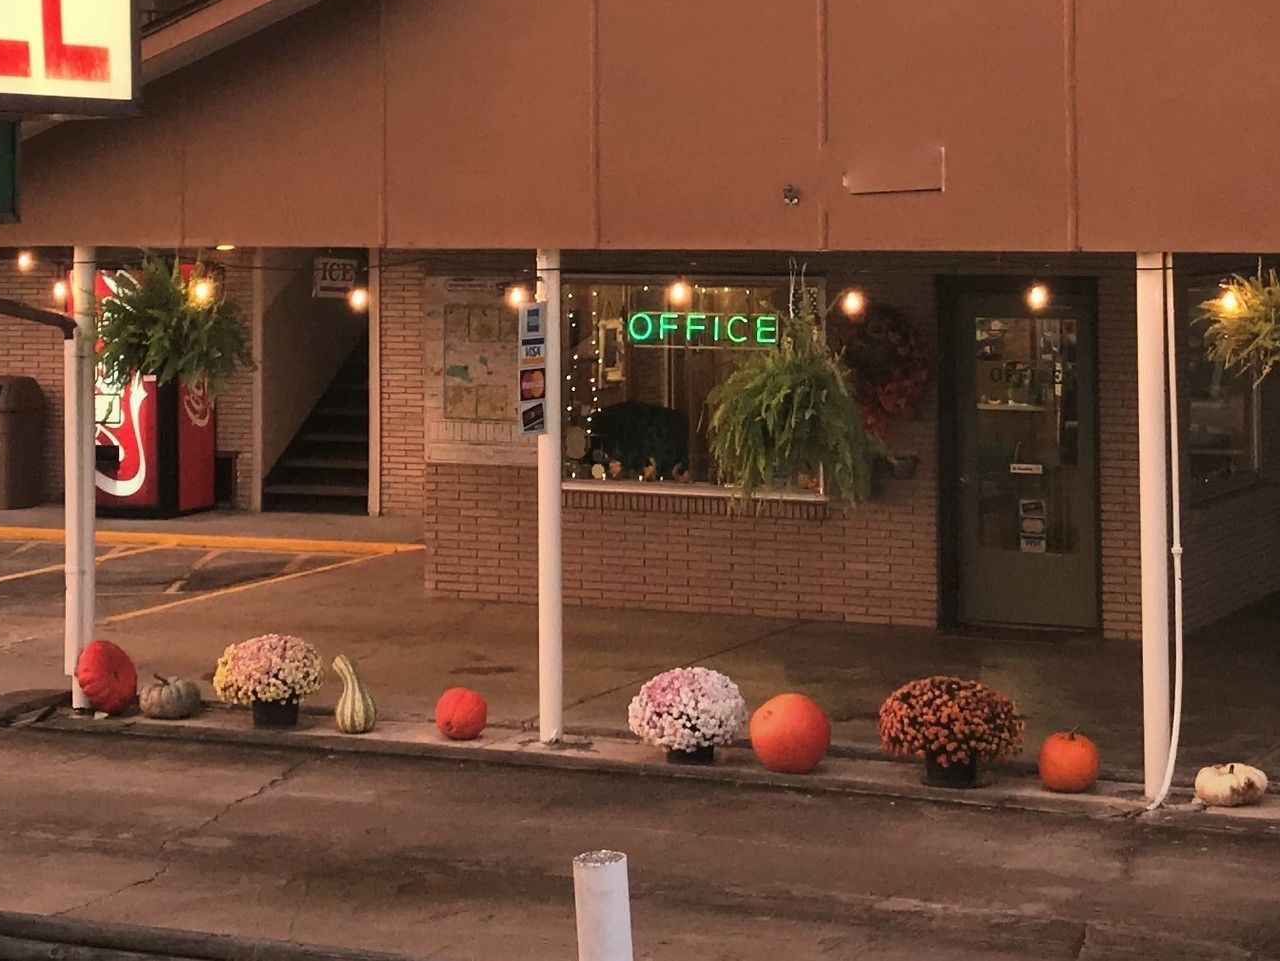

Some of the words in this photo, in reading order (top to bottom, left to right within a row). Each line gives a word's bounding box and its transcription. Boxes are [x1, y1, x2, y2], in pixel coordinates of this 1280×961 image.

[320, 261, 354, 282] ICE
[628, 312, 777, 344] OFFICE
[525, 344, 541, 357] VISA
